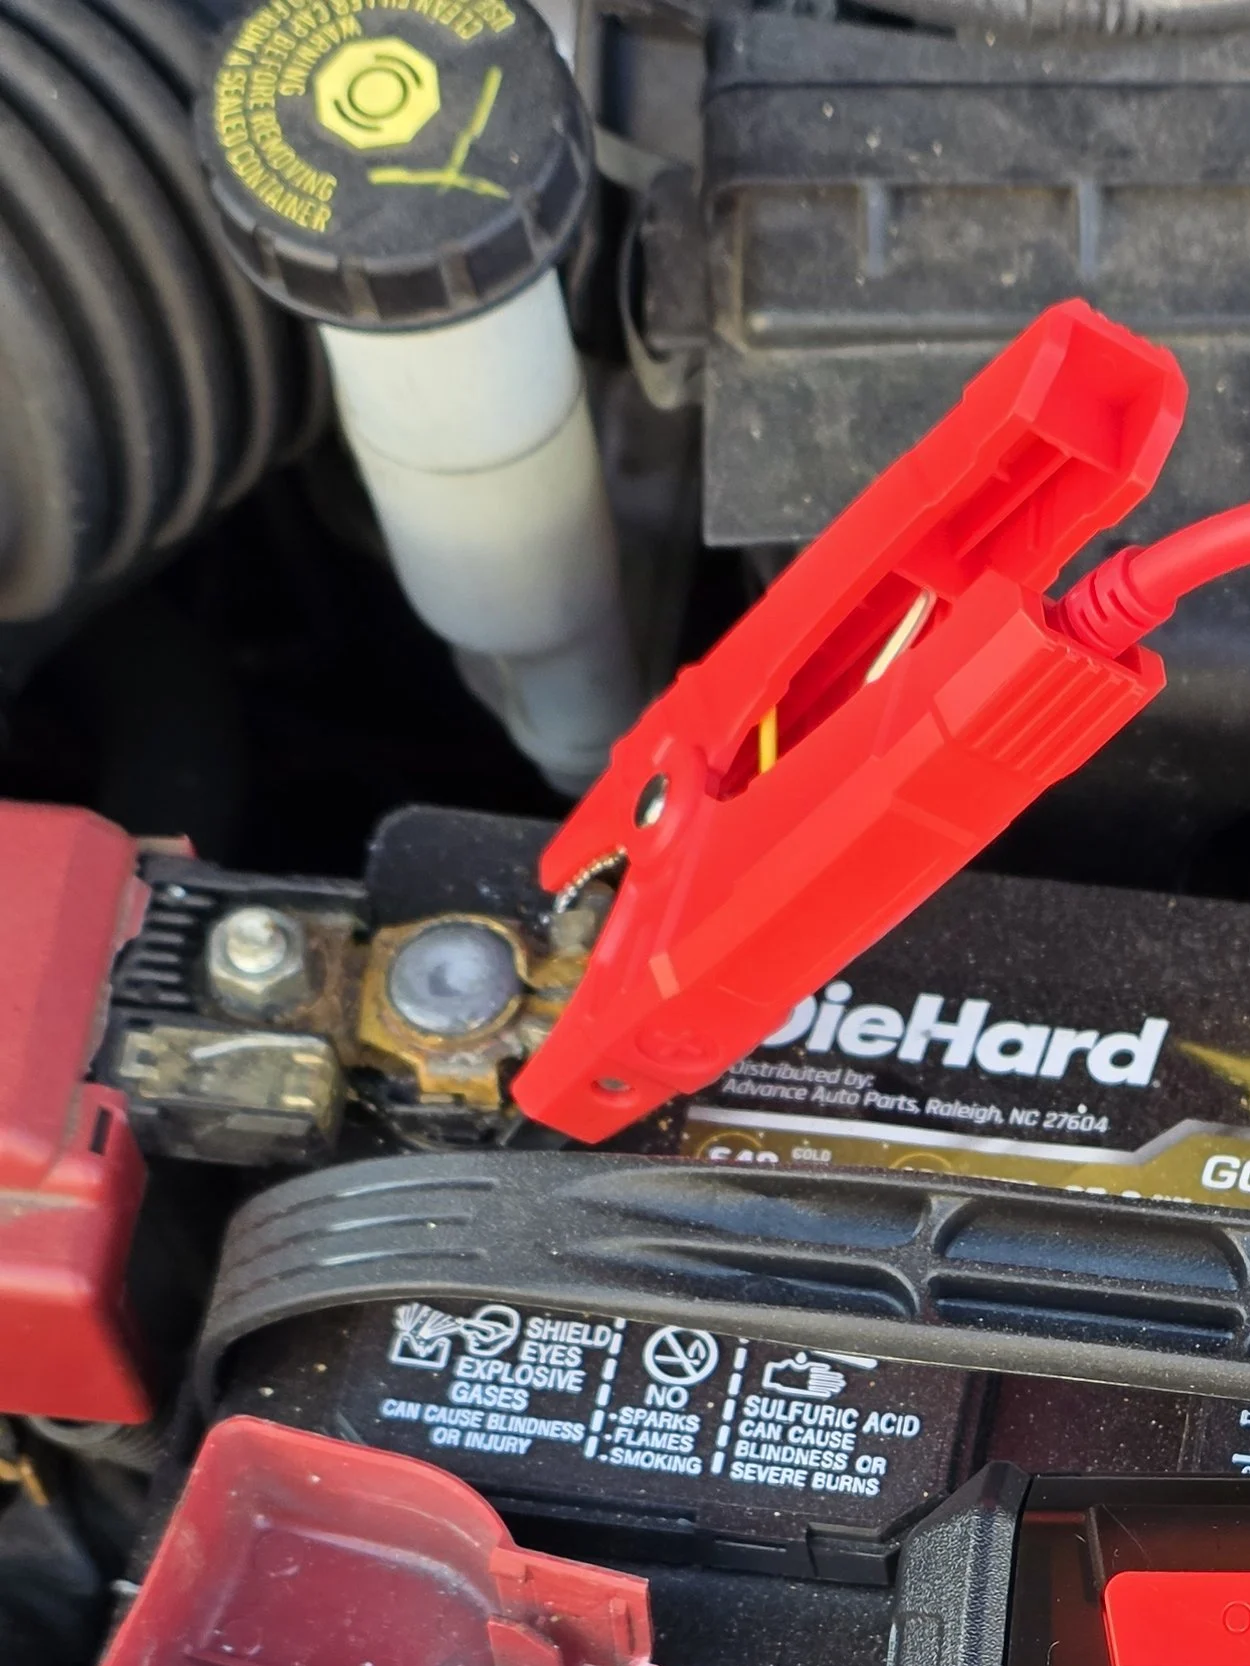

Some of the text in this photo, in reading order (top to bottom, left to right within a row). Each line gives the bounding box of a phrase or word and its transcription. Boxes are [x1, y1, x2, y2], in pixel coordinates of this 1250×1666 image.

[279, 14, 362, 96] WARNING
[214, 0, 332, 233] FROM A SEALED CONTAINER
[249, 1, 338, 202] CAP BEFORE REMOVING
[844, 1069, 874, 1088] by:
[723, 1078, 1108, 1132] Advance Auto Parts, Raleigh, NC 27604
[791, 1147, 832, 1163] GOLD
[526, 1317, 612, 1347] SHIELD
[519, 1341, 583, 1368] EYES
[456, 1355, 587, 1393] EXPLOSIVE
[450, 1381, 529, 1411] GASES
[644, 1384, 689, 1408] NO
[381, 1399, 586, 1441] CAN CAUSE BLINDNESS
[618, 1406, 700, 1433] SPARKS
[743, 1395, 921, 1438] SULFURIC ACID
[432, 1427, 532, 1455] OR INJURY
[614, 1427, 695, 1453] FLAMES
[738, 1420, 857, 1451] CAN CAUSE
[610, 1447, 703, 1475] SMOKING
[734, 1440, 887, 1475] BLINDNESS OR
[729, 1461, 880, 1496] SEVERE BURNS
